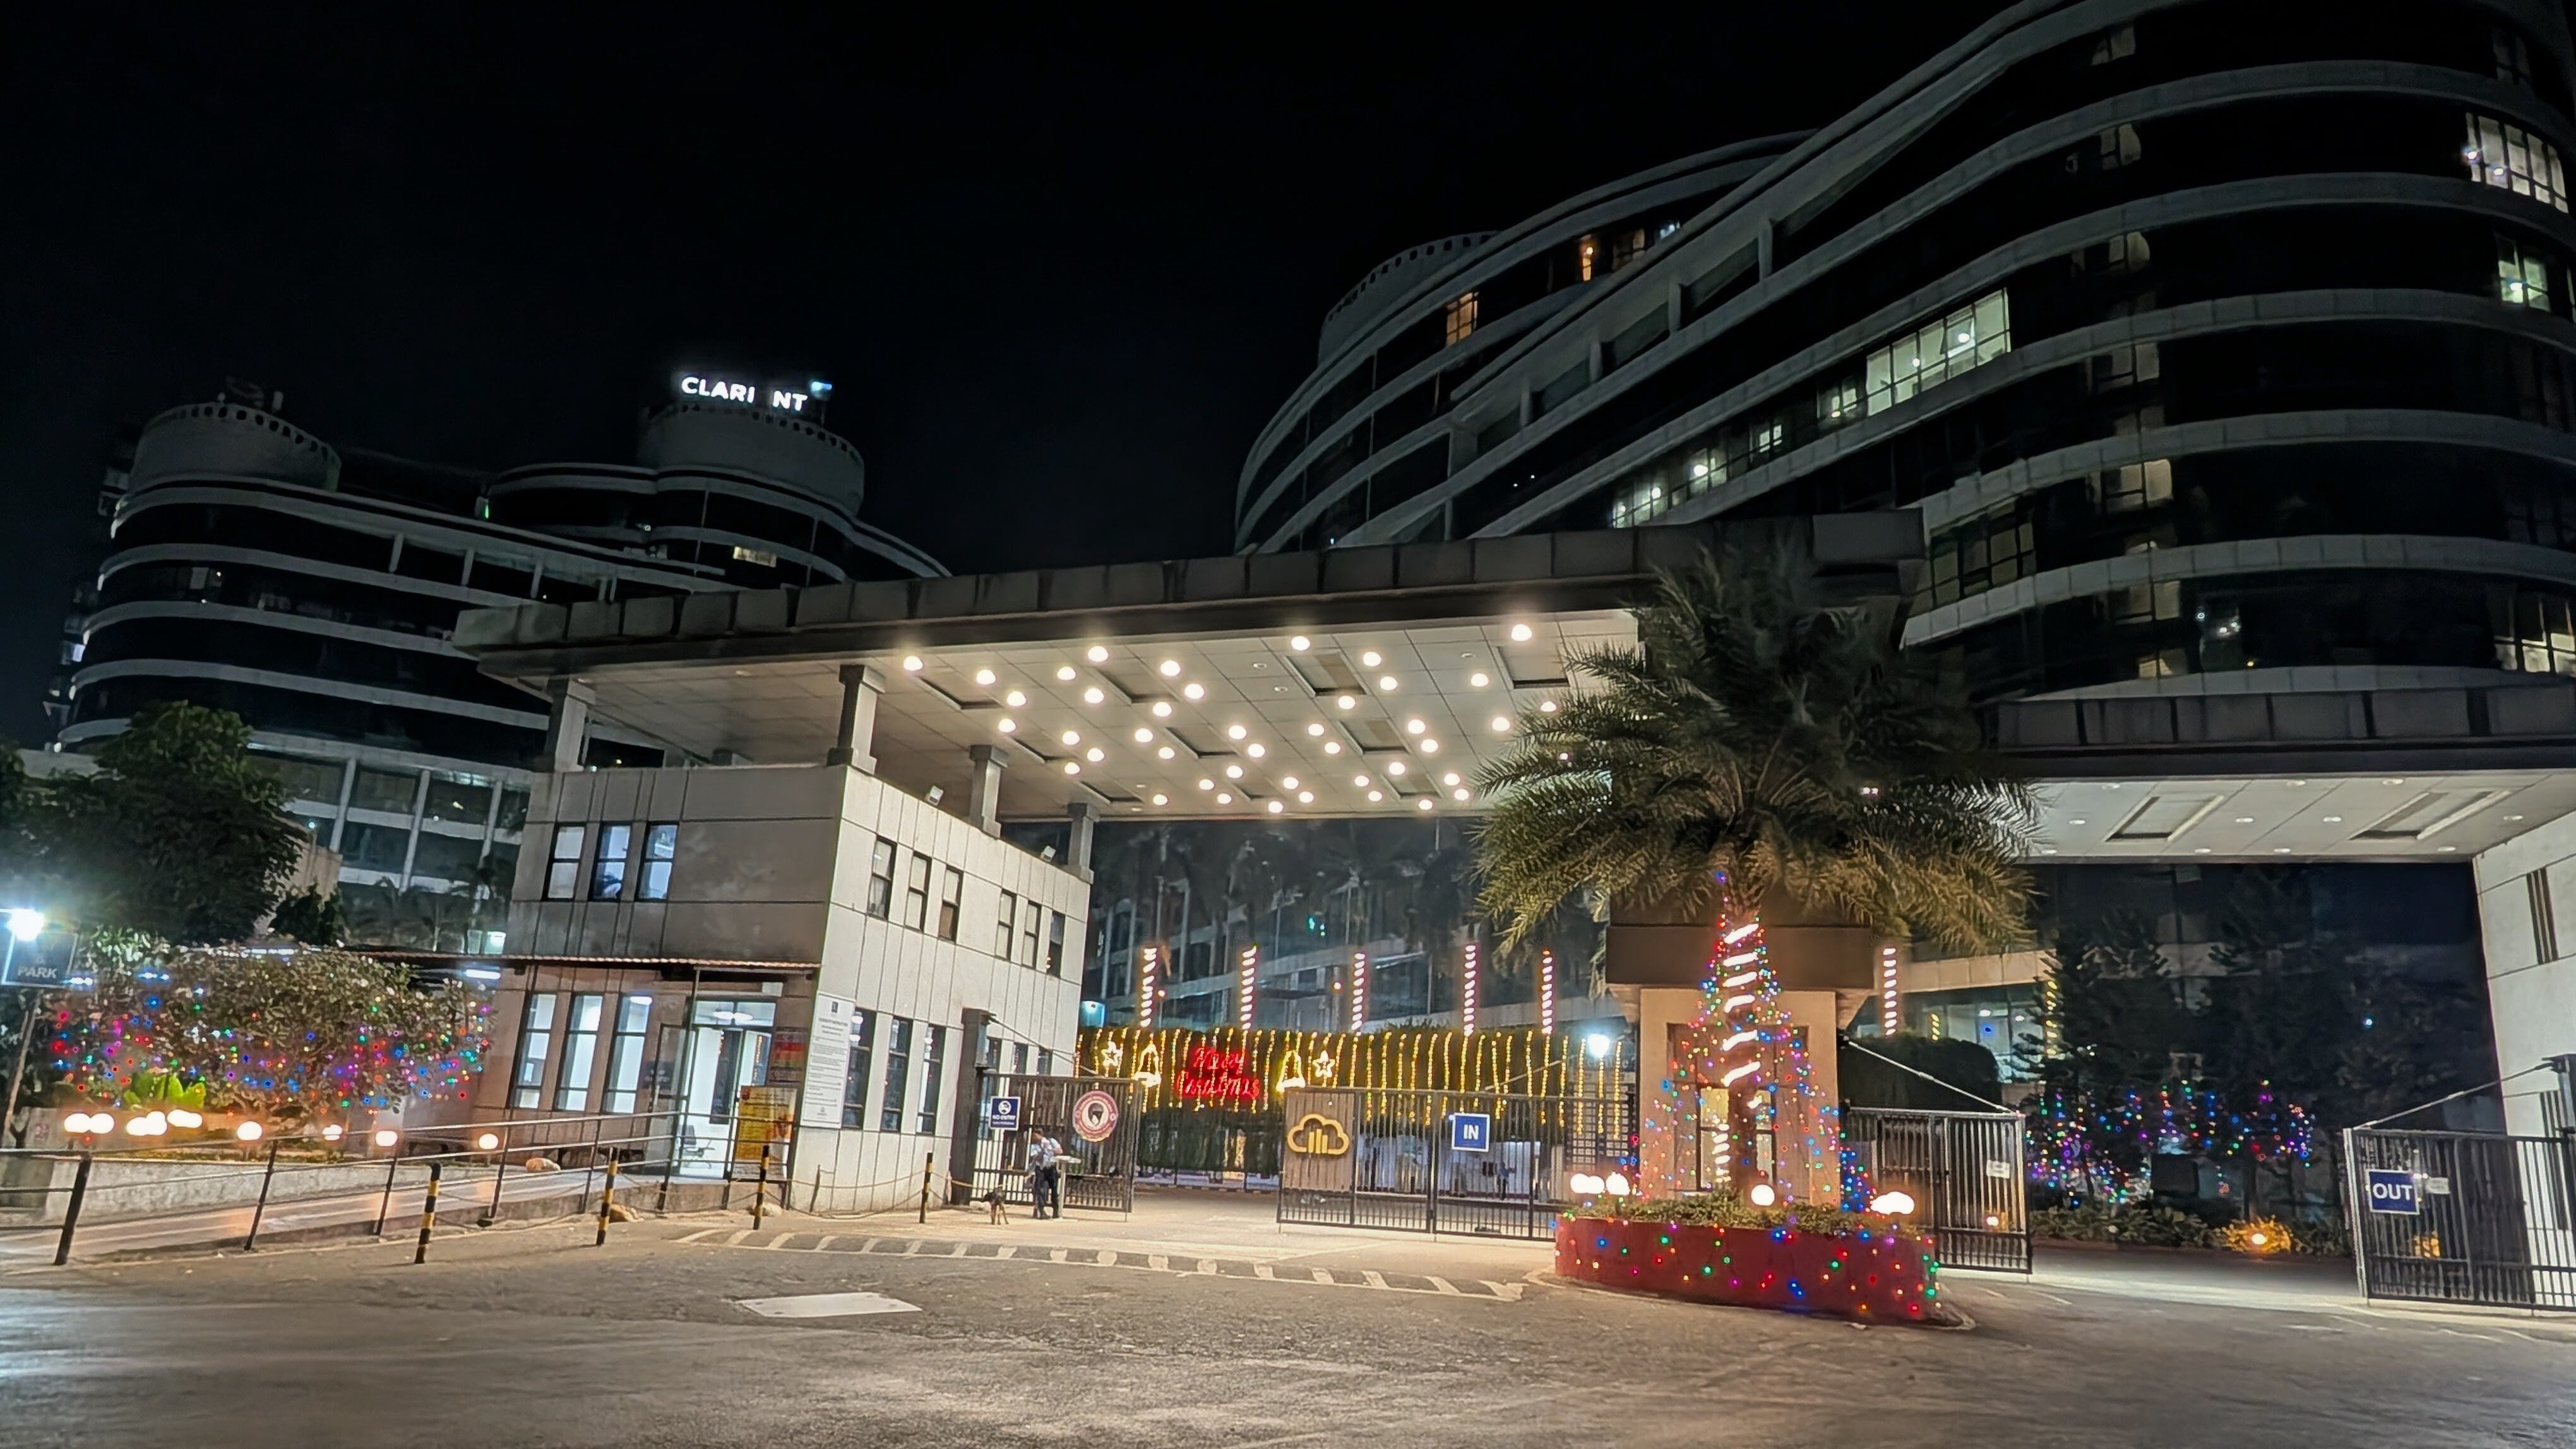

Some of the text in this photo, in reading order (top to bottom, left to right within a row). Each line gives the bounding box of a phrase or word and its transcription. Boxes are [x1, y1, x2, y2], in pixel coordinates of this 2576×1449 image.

[681, 376, 808, 411] CLARINT
[18, 966, 57, 979] PARK
[1464, 1124, 1479, 1140] IN
[2373, 1183, 2412, 1200] OUT
